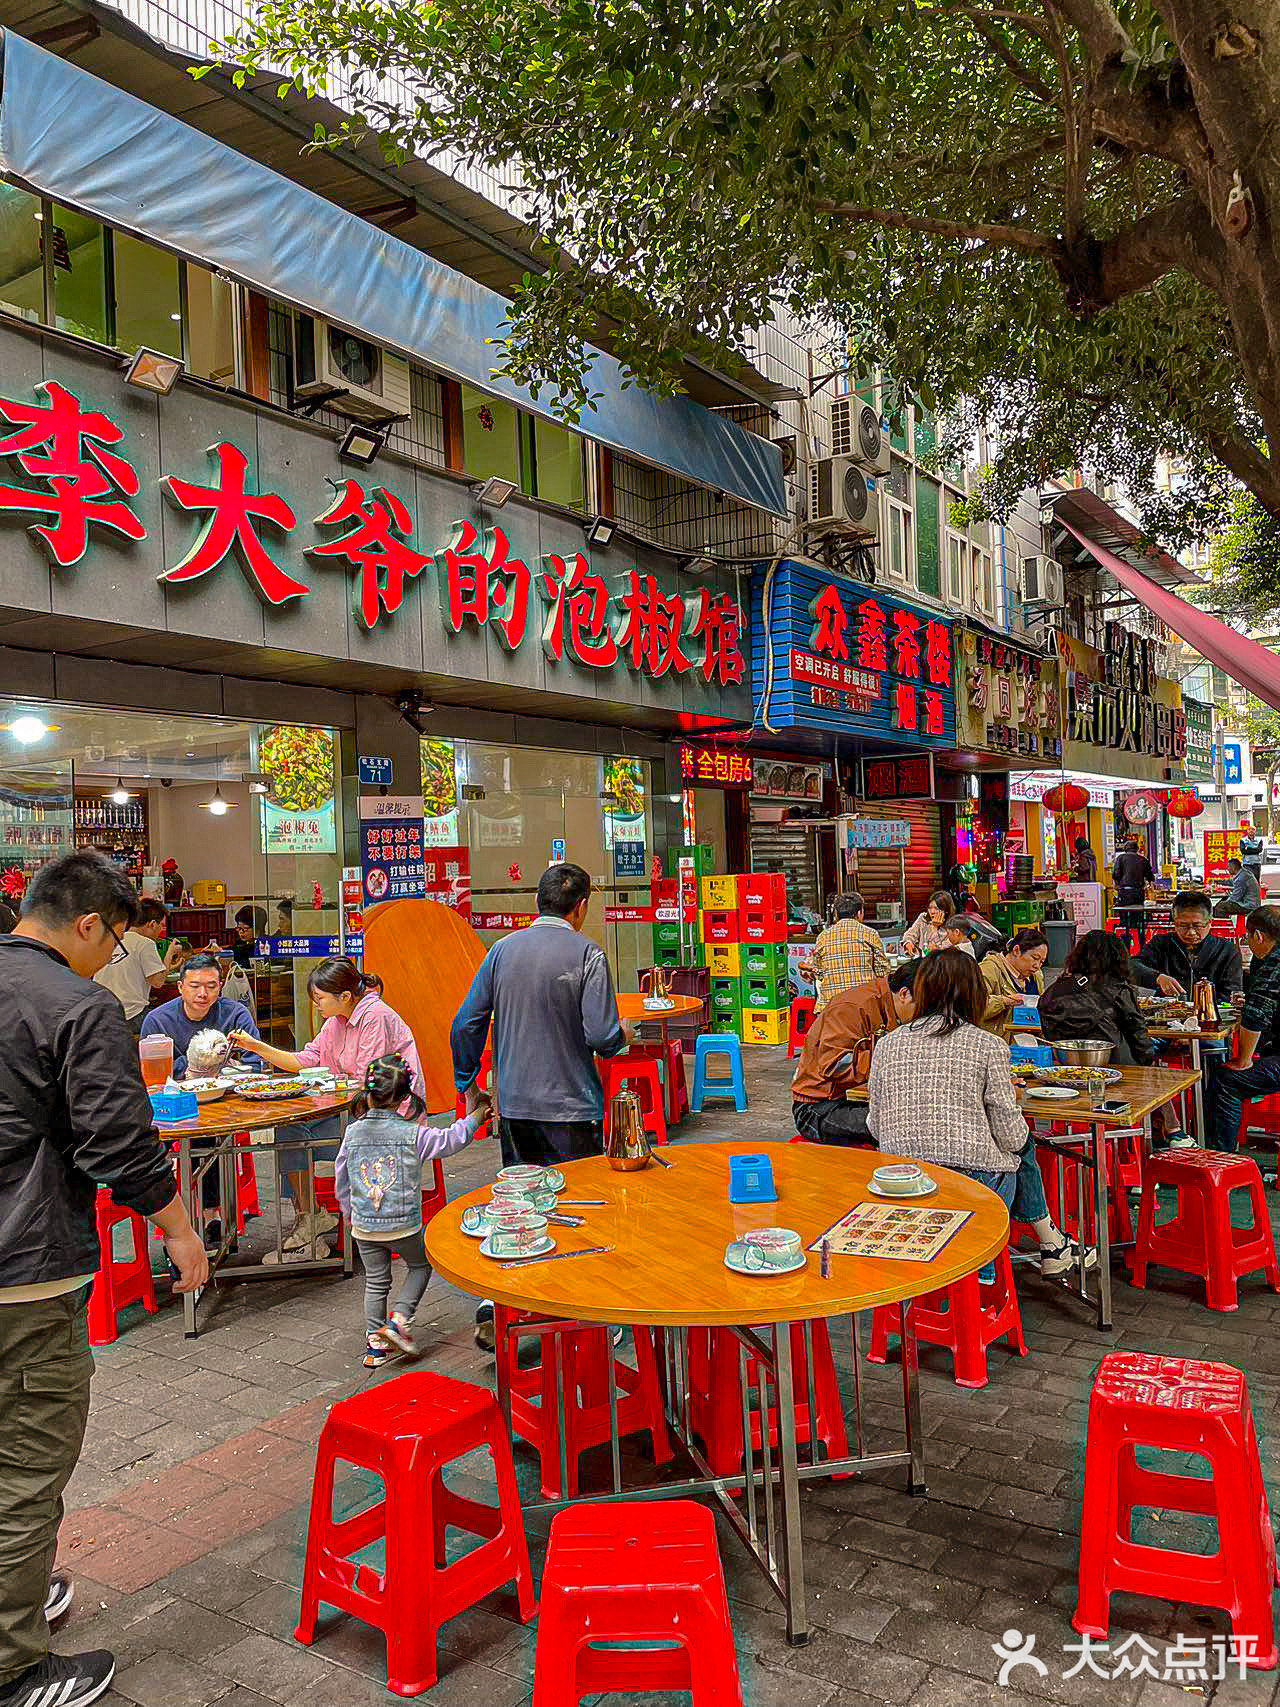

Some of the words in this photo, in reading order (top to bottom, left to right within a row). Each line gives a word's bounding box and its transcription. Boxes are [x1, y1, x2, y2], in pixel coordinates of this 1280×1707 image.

[0, 379, 747, 687] 李大爷的泡椒馆
[815, 584, 951, 688] 众鑫茶楼
[370, 769, 382, 782] 71
[367, 828, 420, 845] 好好过年
[367, 844, 422, 862] 不要打架
[389, 864, 425, 878] 打输住院
[390, 881, 426, 895] 打赢坐牢
